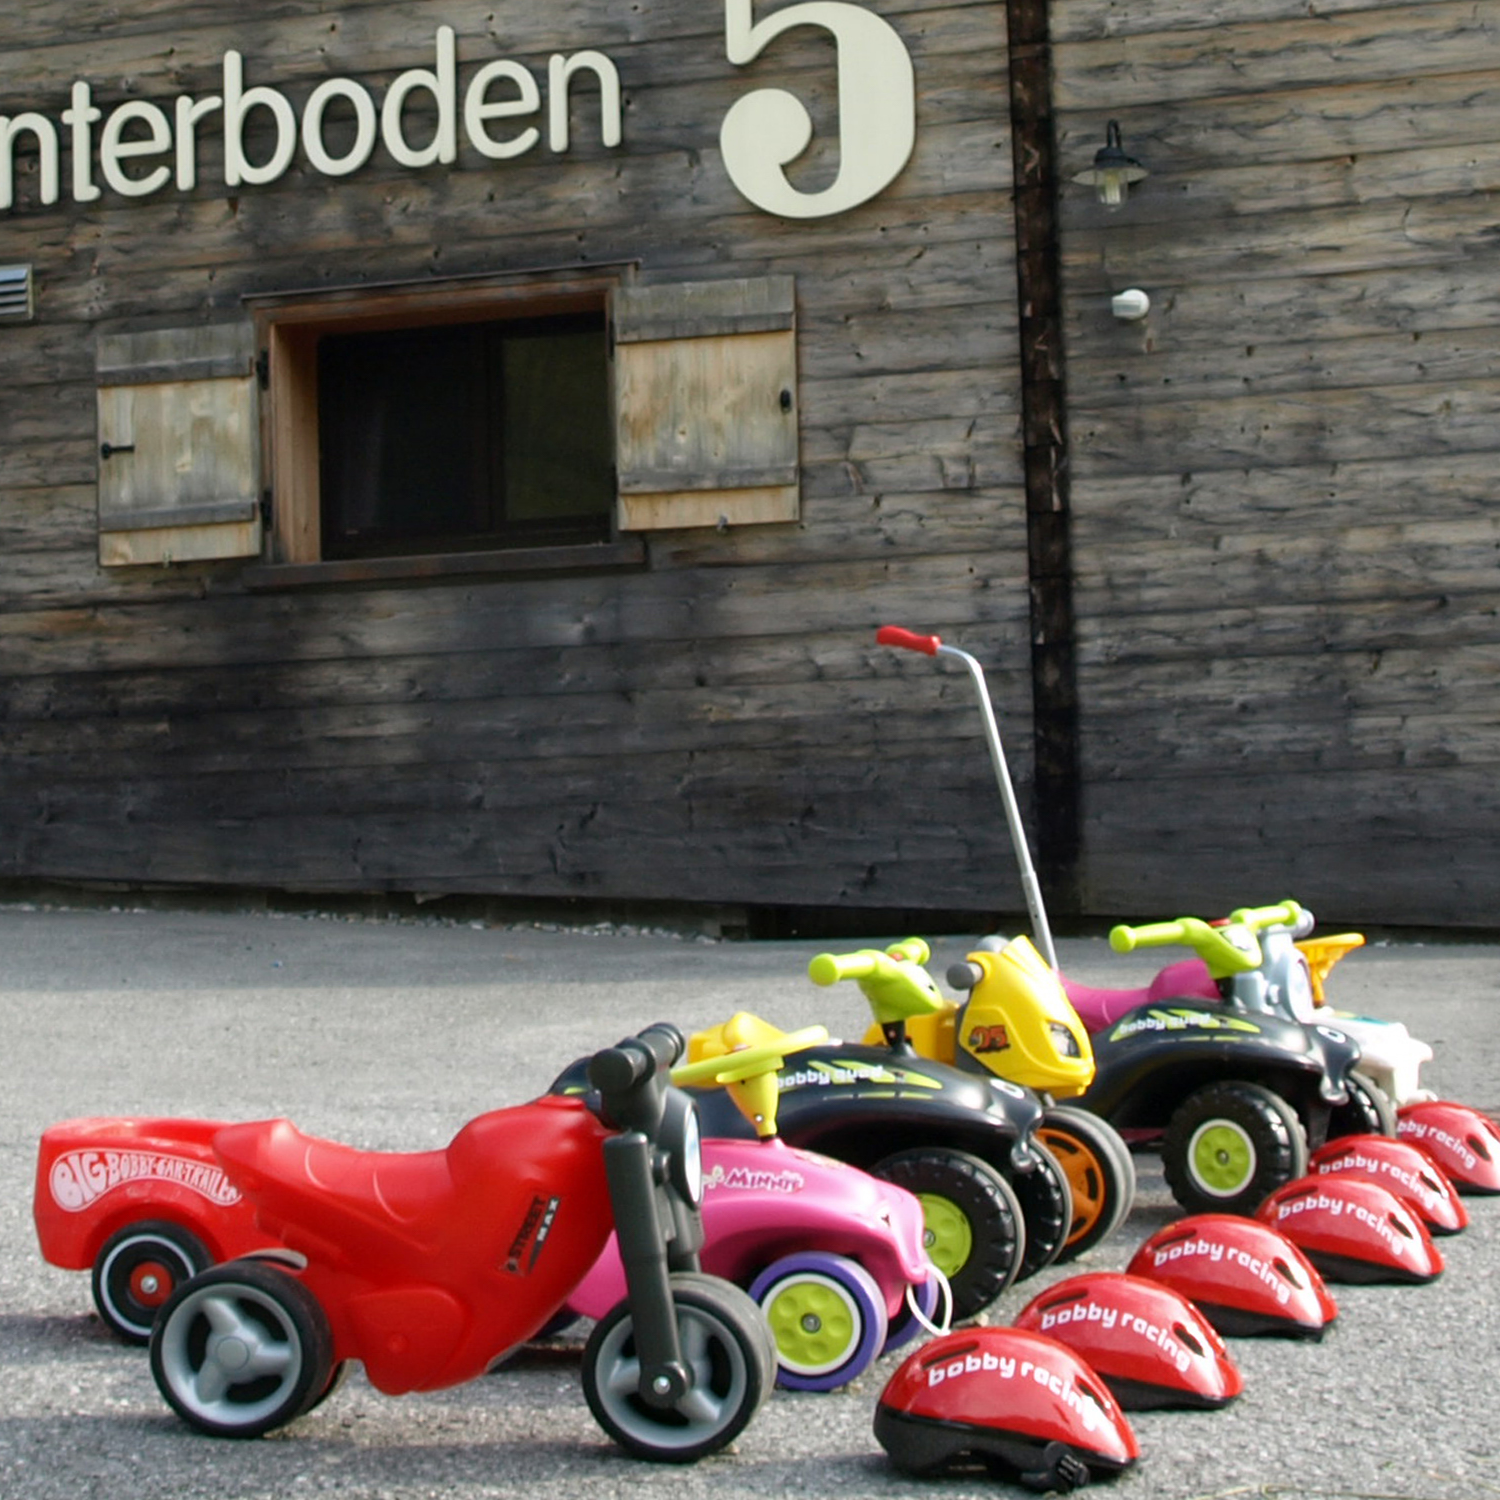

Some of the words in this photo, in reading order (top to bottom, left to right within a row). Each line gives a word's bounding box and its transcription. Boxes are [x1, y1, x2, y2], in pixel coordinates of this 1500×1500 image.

[1428, 1126, 1477, 1169] racing
[52, 1151, 107, 1206] BIG
[1319, 1154, 1379, 1174] bobby
[1381, 1161, 1438, 1209] racing
[1278, 1195, 1343, 1220] bobby
[1346, 1202, 1404, 1255] racing
[1154, 1239, 1224, 1267] bobby
[1226, 1247, 1292, 1304] racing
[1041, 1302, 1118, 1330] bobby
[1121, 1312, 1192, 1372] racing
[928, 1353, 1016, 1387] bobby
[1020, 1361, 1100, 1431] racing
